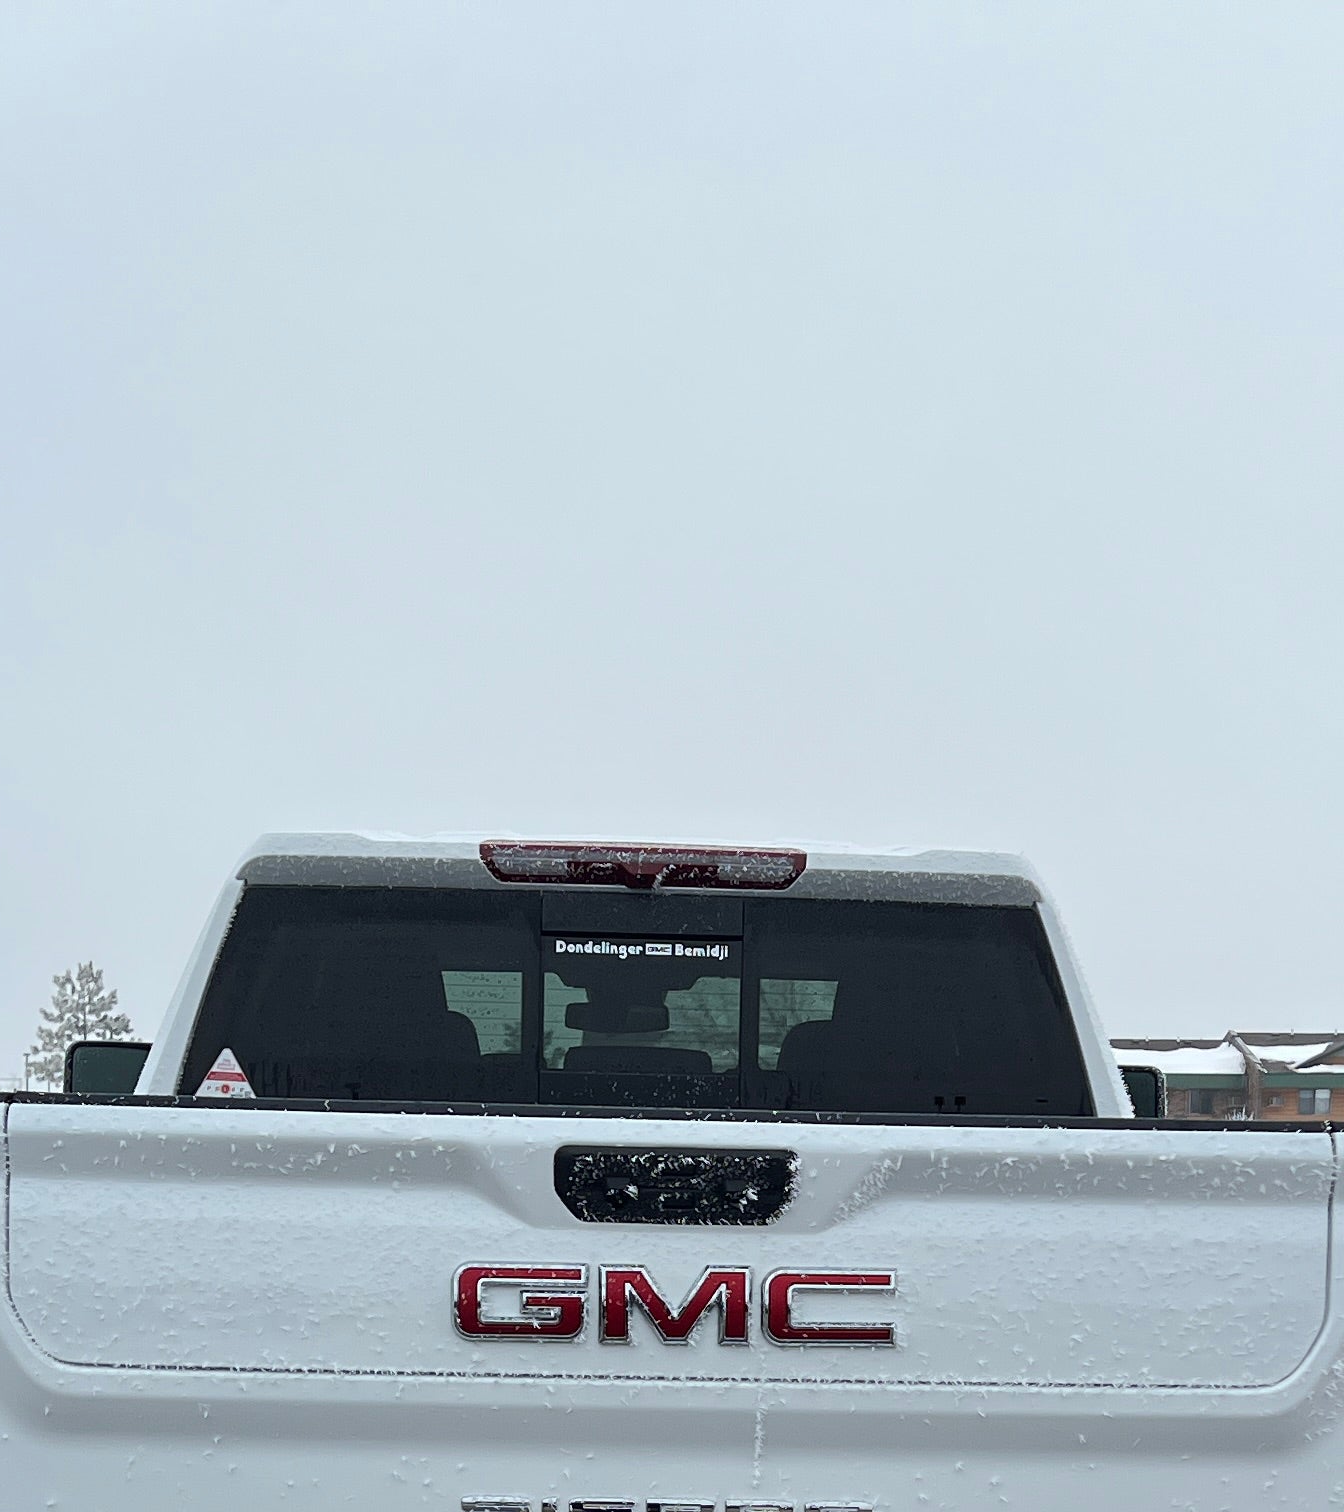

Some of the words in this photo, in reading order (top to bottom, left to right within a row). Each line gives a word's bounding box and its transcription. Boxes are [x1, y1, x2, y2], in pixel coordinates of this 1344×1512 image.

[556, 940, 643, 959] Dondelinger
[674, 943, 729, 960] Bemidji
[452, 1260, 898, 1348] GMC
